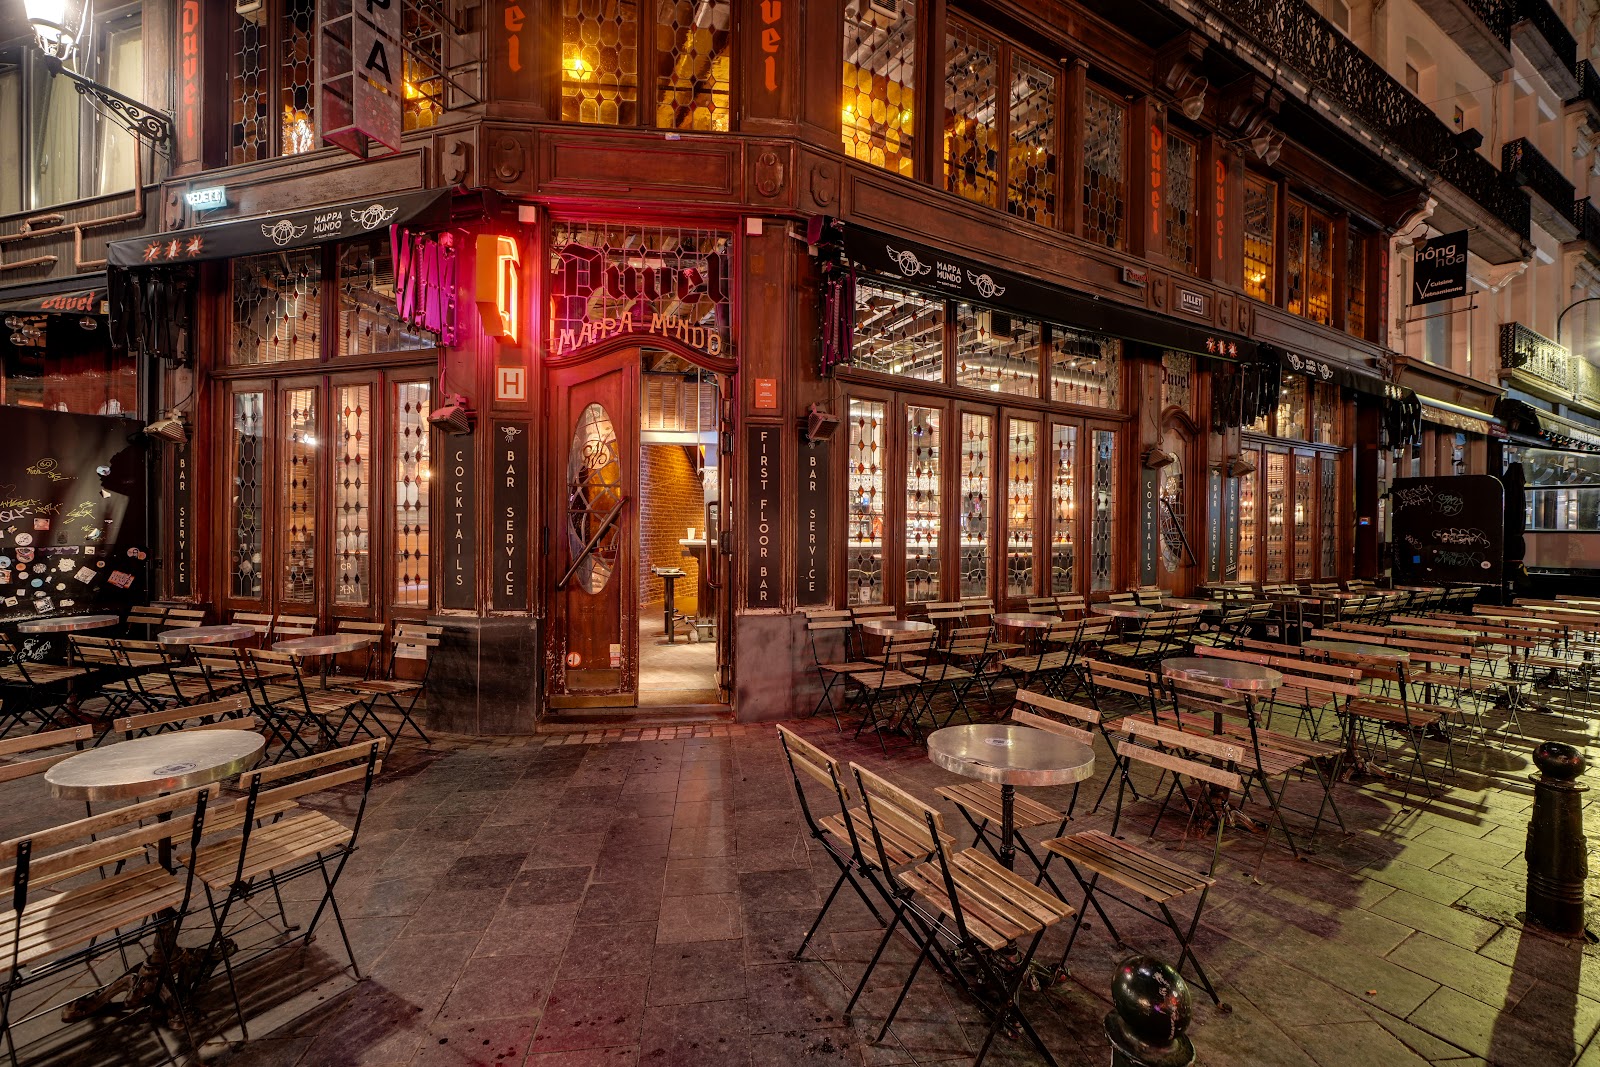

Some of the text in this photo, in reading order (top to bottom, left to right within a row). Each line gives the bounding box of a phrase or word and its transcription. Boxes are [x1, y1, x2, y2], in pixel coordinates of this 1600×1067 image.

[505, 0, 526, 72] el
[183, 1, 199, 139] Duvel
[1151, 124, 1162, 235] Duvel
[313, 220, 342, 233] MUNDO
[314, 212, 343, 224] MAPPA
[1216, 160, 1226, 260] Duvel
[936, 260, 962, 276] MAPPA
[936, 269, 962, 284] MUNDO
[1430, 279, 1454, 287] Cuisine
[1183, 293, 1202, 306] LILLET
[557, 311, 722, 355] MAPPA MUNDO
[504, 372, 519, 395] H
[455, 451, 465, 586] COCKTAILS
[505, 451, 516, 596] BAR SERVICE
[759, 432, 769, 601] FIRST FLOOR BAR
[808, 457, 817, 592] BAR SERVICE
